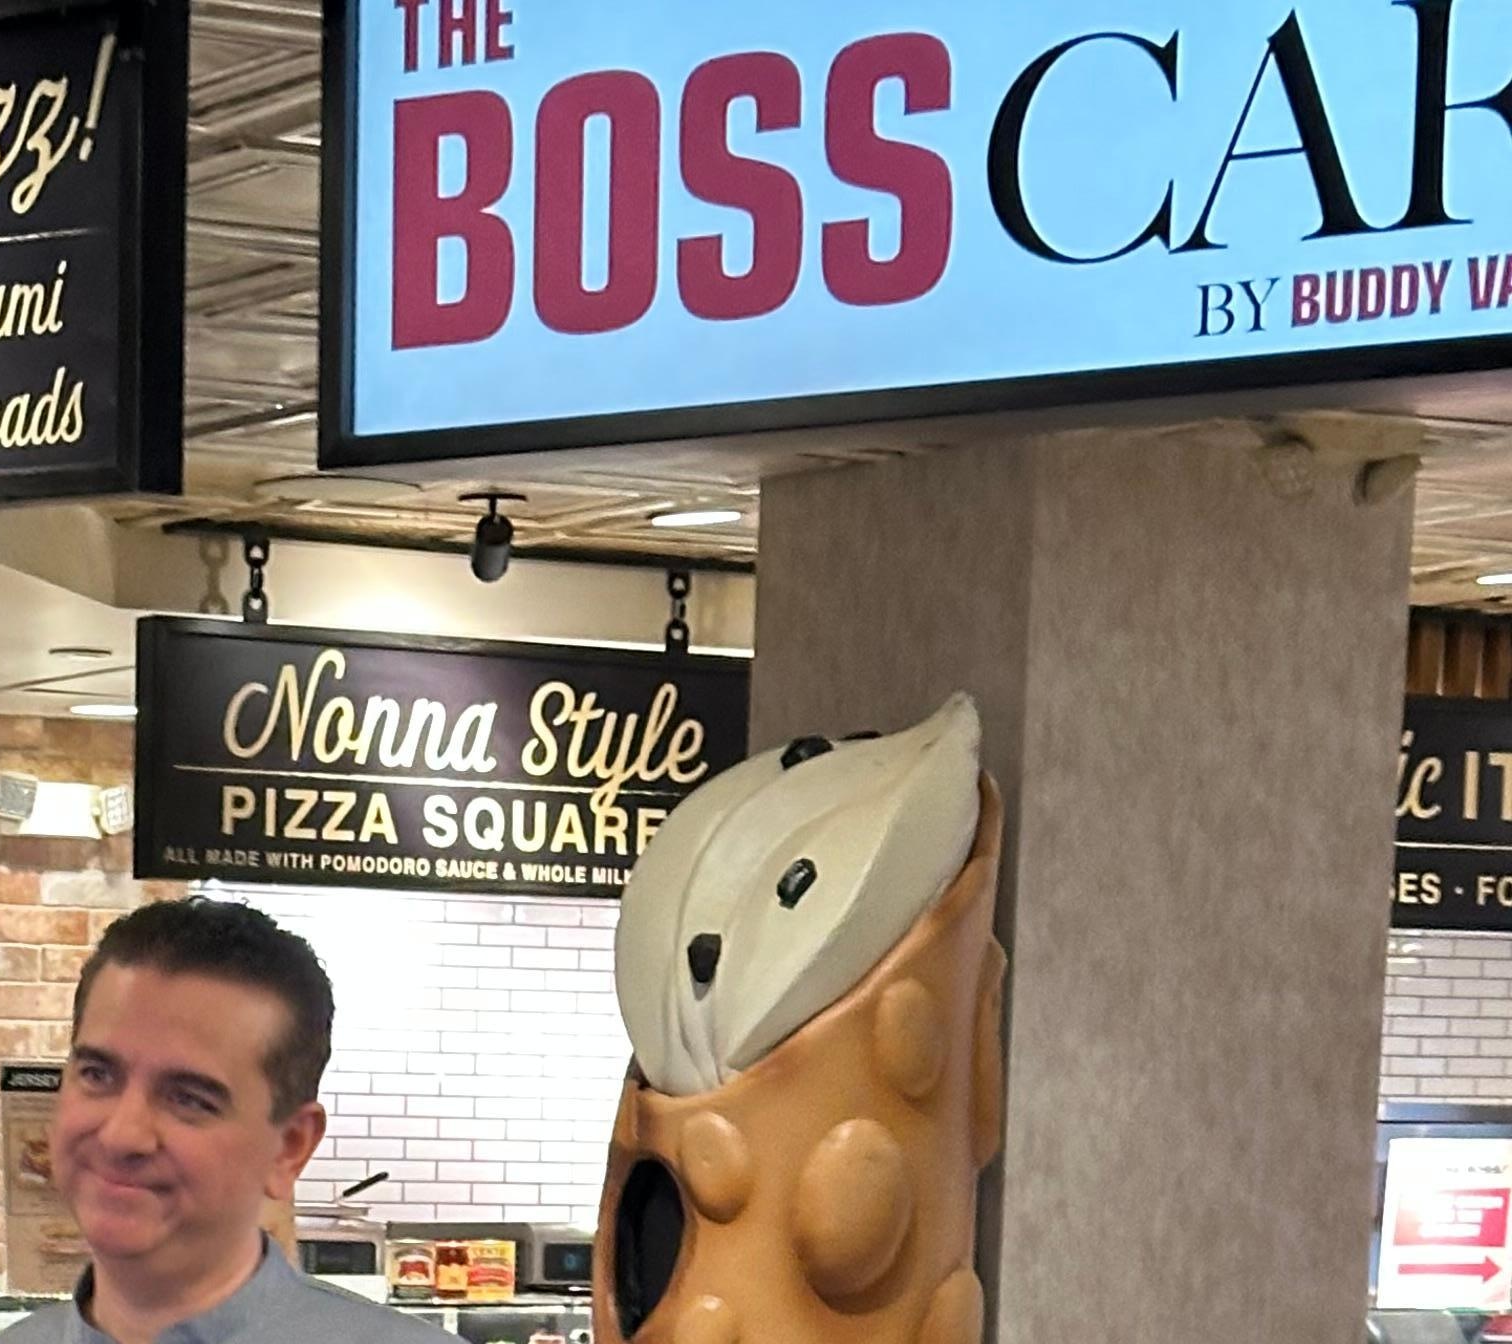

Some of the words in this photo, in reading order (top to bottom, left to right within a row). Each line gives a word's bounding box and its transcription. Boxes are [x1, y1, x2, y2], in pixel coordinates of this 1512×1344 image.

[394, 0, 515, 73] THE
[391, 31, 953, 351] BOSS
[1193, 276, 1281, 337] BY
[1290, 259, 1452, 328] BUDDY
[222, 648, 499, 773] Nonna
[522, 680, 708, 815] Style
[222, 785, 398, 845] PIZZA
[265, 852, 314, 869] WITH
[320, 854, 431, 876] POMODORO
[435, 858, 498, 880] SAUCE
[502, 861, 517, 880] &
[521, 863, 586, 883] WHOLE
